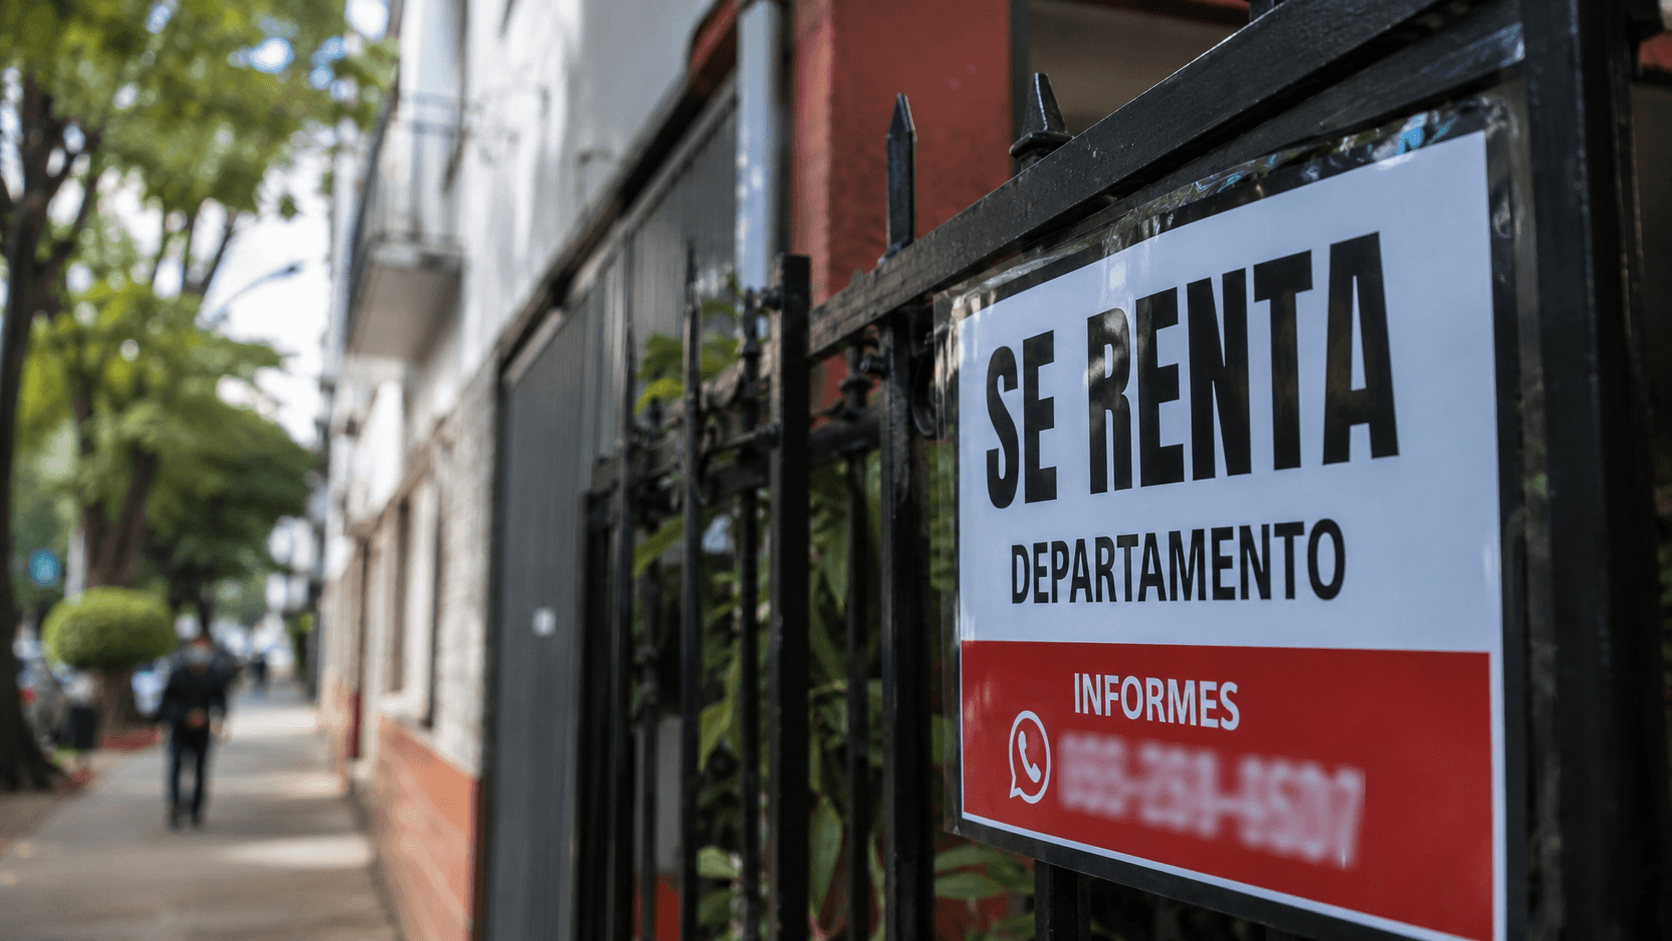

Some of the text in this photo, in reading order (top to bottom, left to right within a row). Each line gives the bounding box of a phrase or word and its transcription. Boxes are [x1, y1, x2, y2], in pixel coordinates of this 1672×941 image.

[986, 230, 1400, 510] SE RENTA
[1011, 517, 1347, 605] DEPARTAMENTO
[1074, 672, 1240, 731] INFORMES
